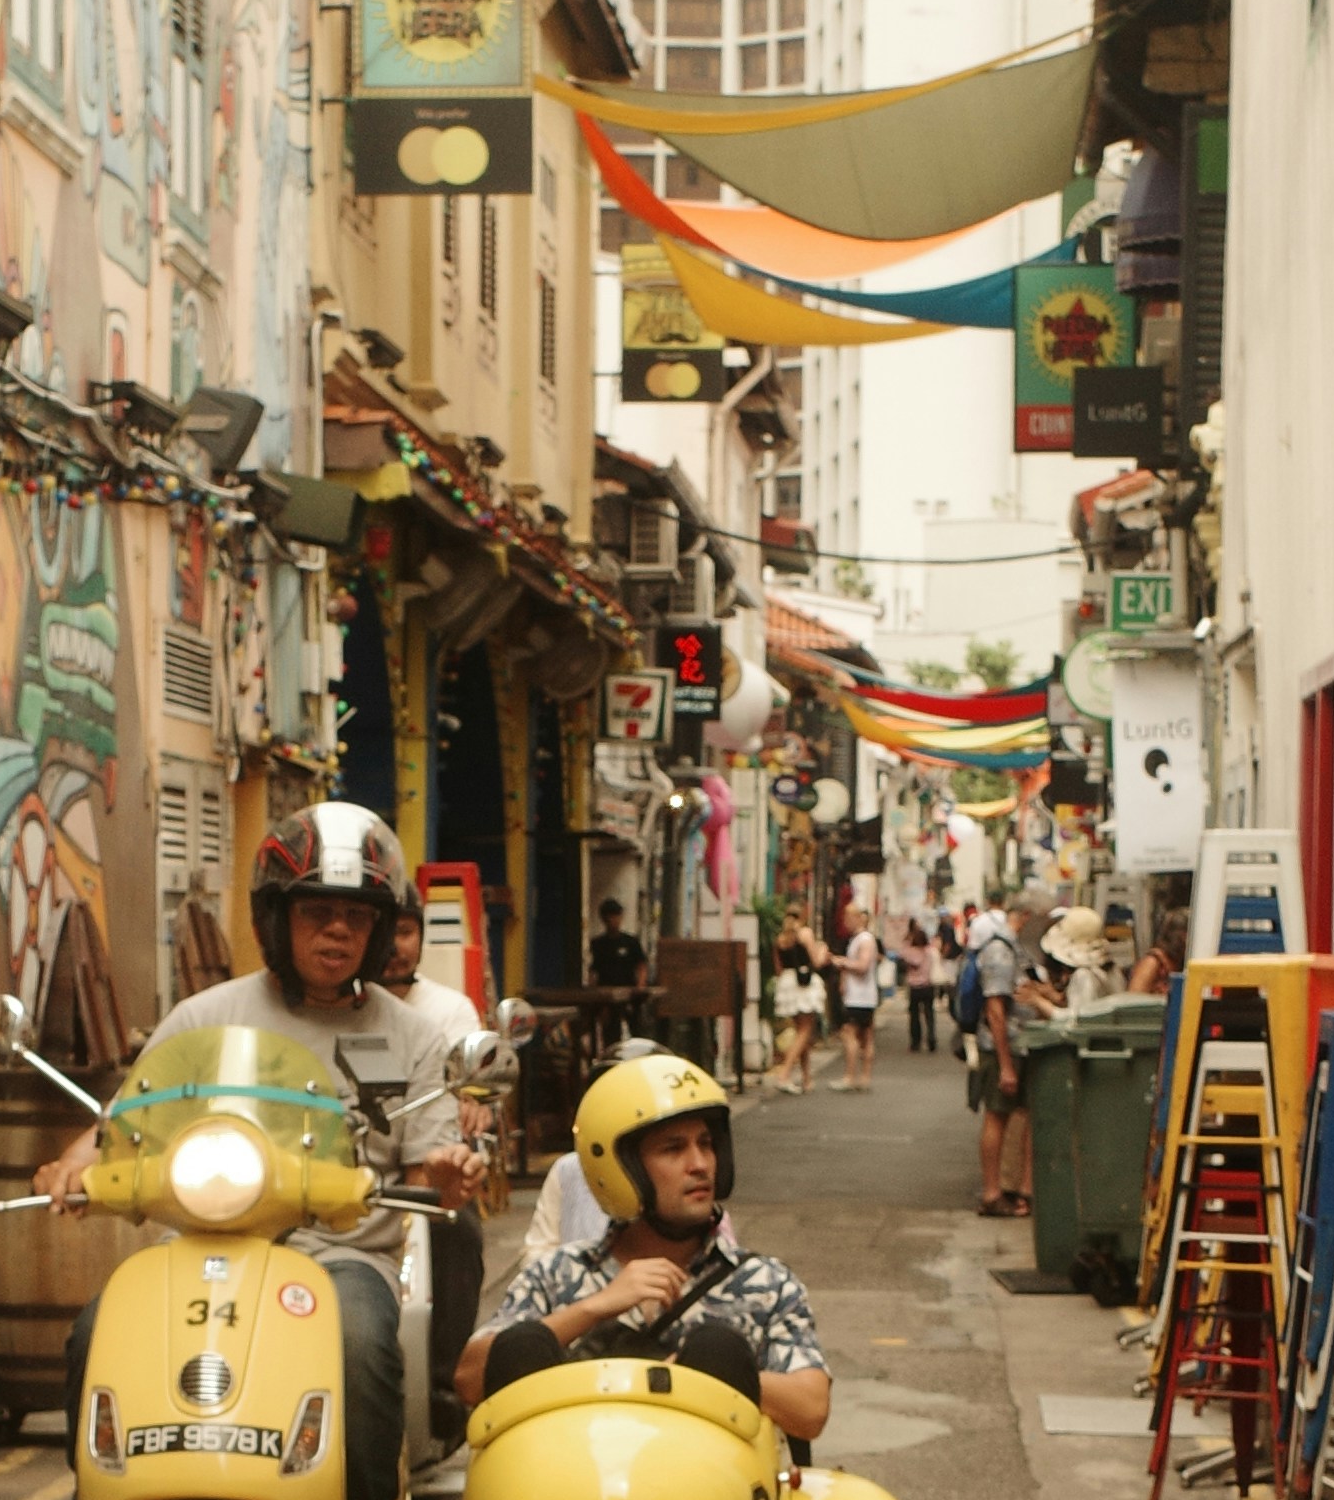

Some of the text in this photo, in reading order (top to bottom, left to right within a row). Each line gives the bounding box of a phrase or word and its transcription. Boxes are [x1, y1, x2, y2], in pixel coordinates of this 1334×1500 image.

[1120, 579, 1167, 615] EXI
[1123, 718, 1194, 741] LuntG
[663, 1070, 700, 1089] 34
[186, 1300, 240, 1328] 34
[127, 1425, 281, 1457] FBF 9578 K
